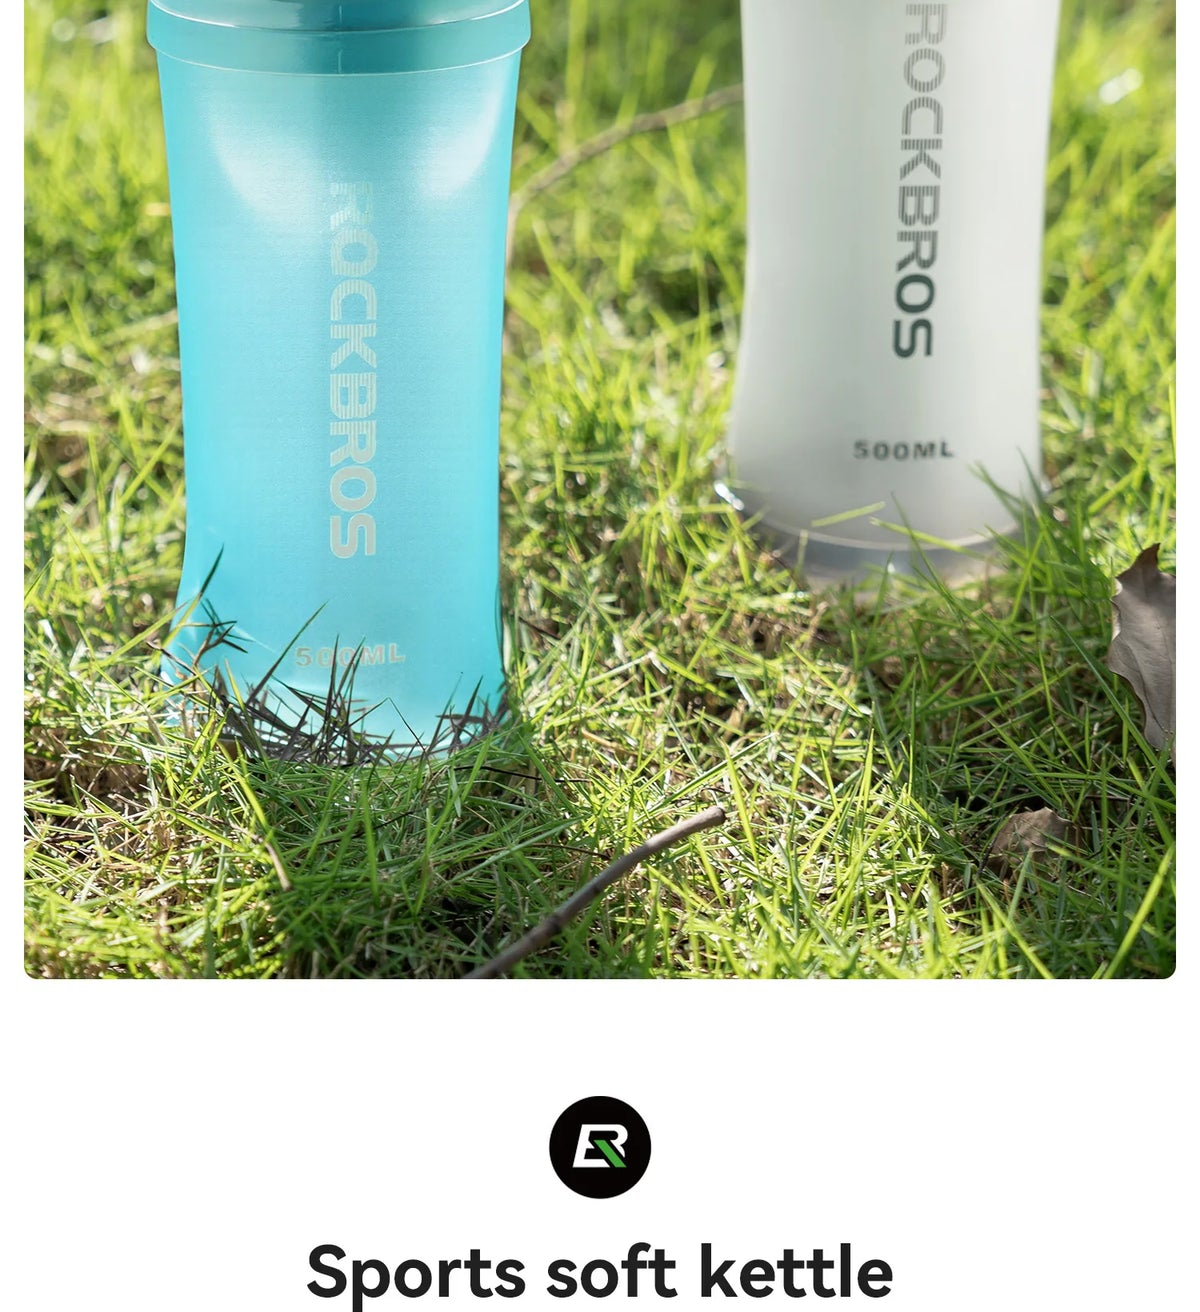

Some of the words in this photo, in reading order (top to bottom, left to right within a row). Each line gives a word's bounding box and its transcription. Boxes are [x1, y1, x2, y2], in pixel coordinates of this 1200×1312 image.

[892, 2, 948, 359] ROCKBROS
[329, 180, 378, 559] ROCKBROS
[853, 439, 955, 461] 500ML
[295, 643, 405, 667] 500ML
